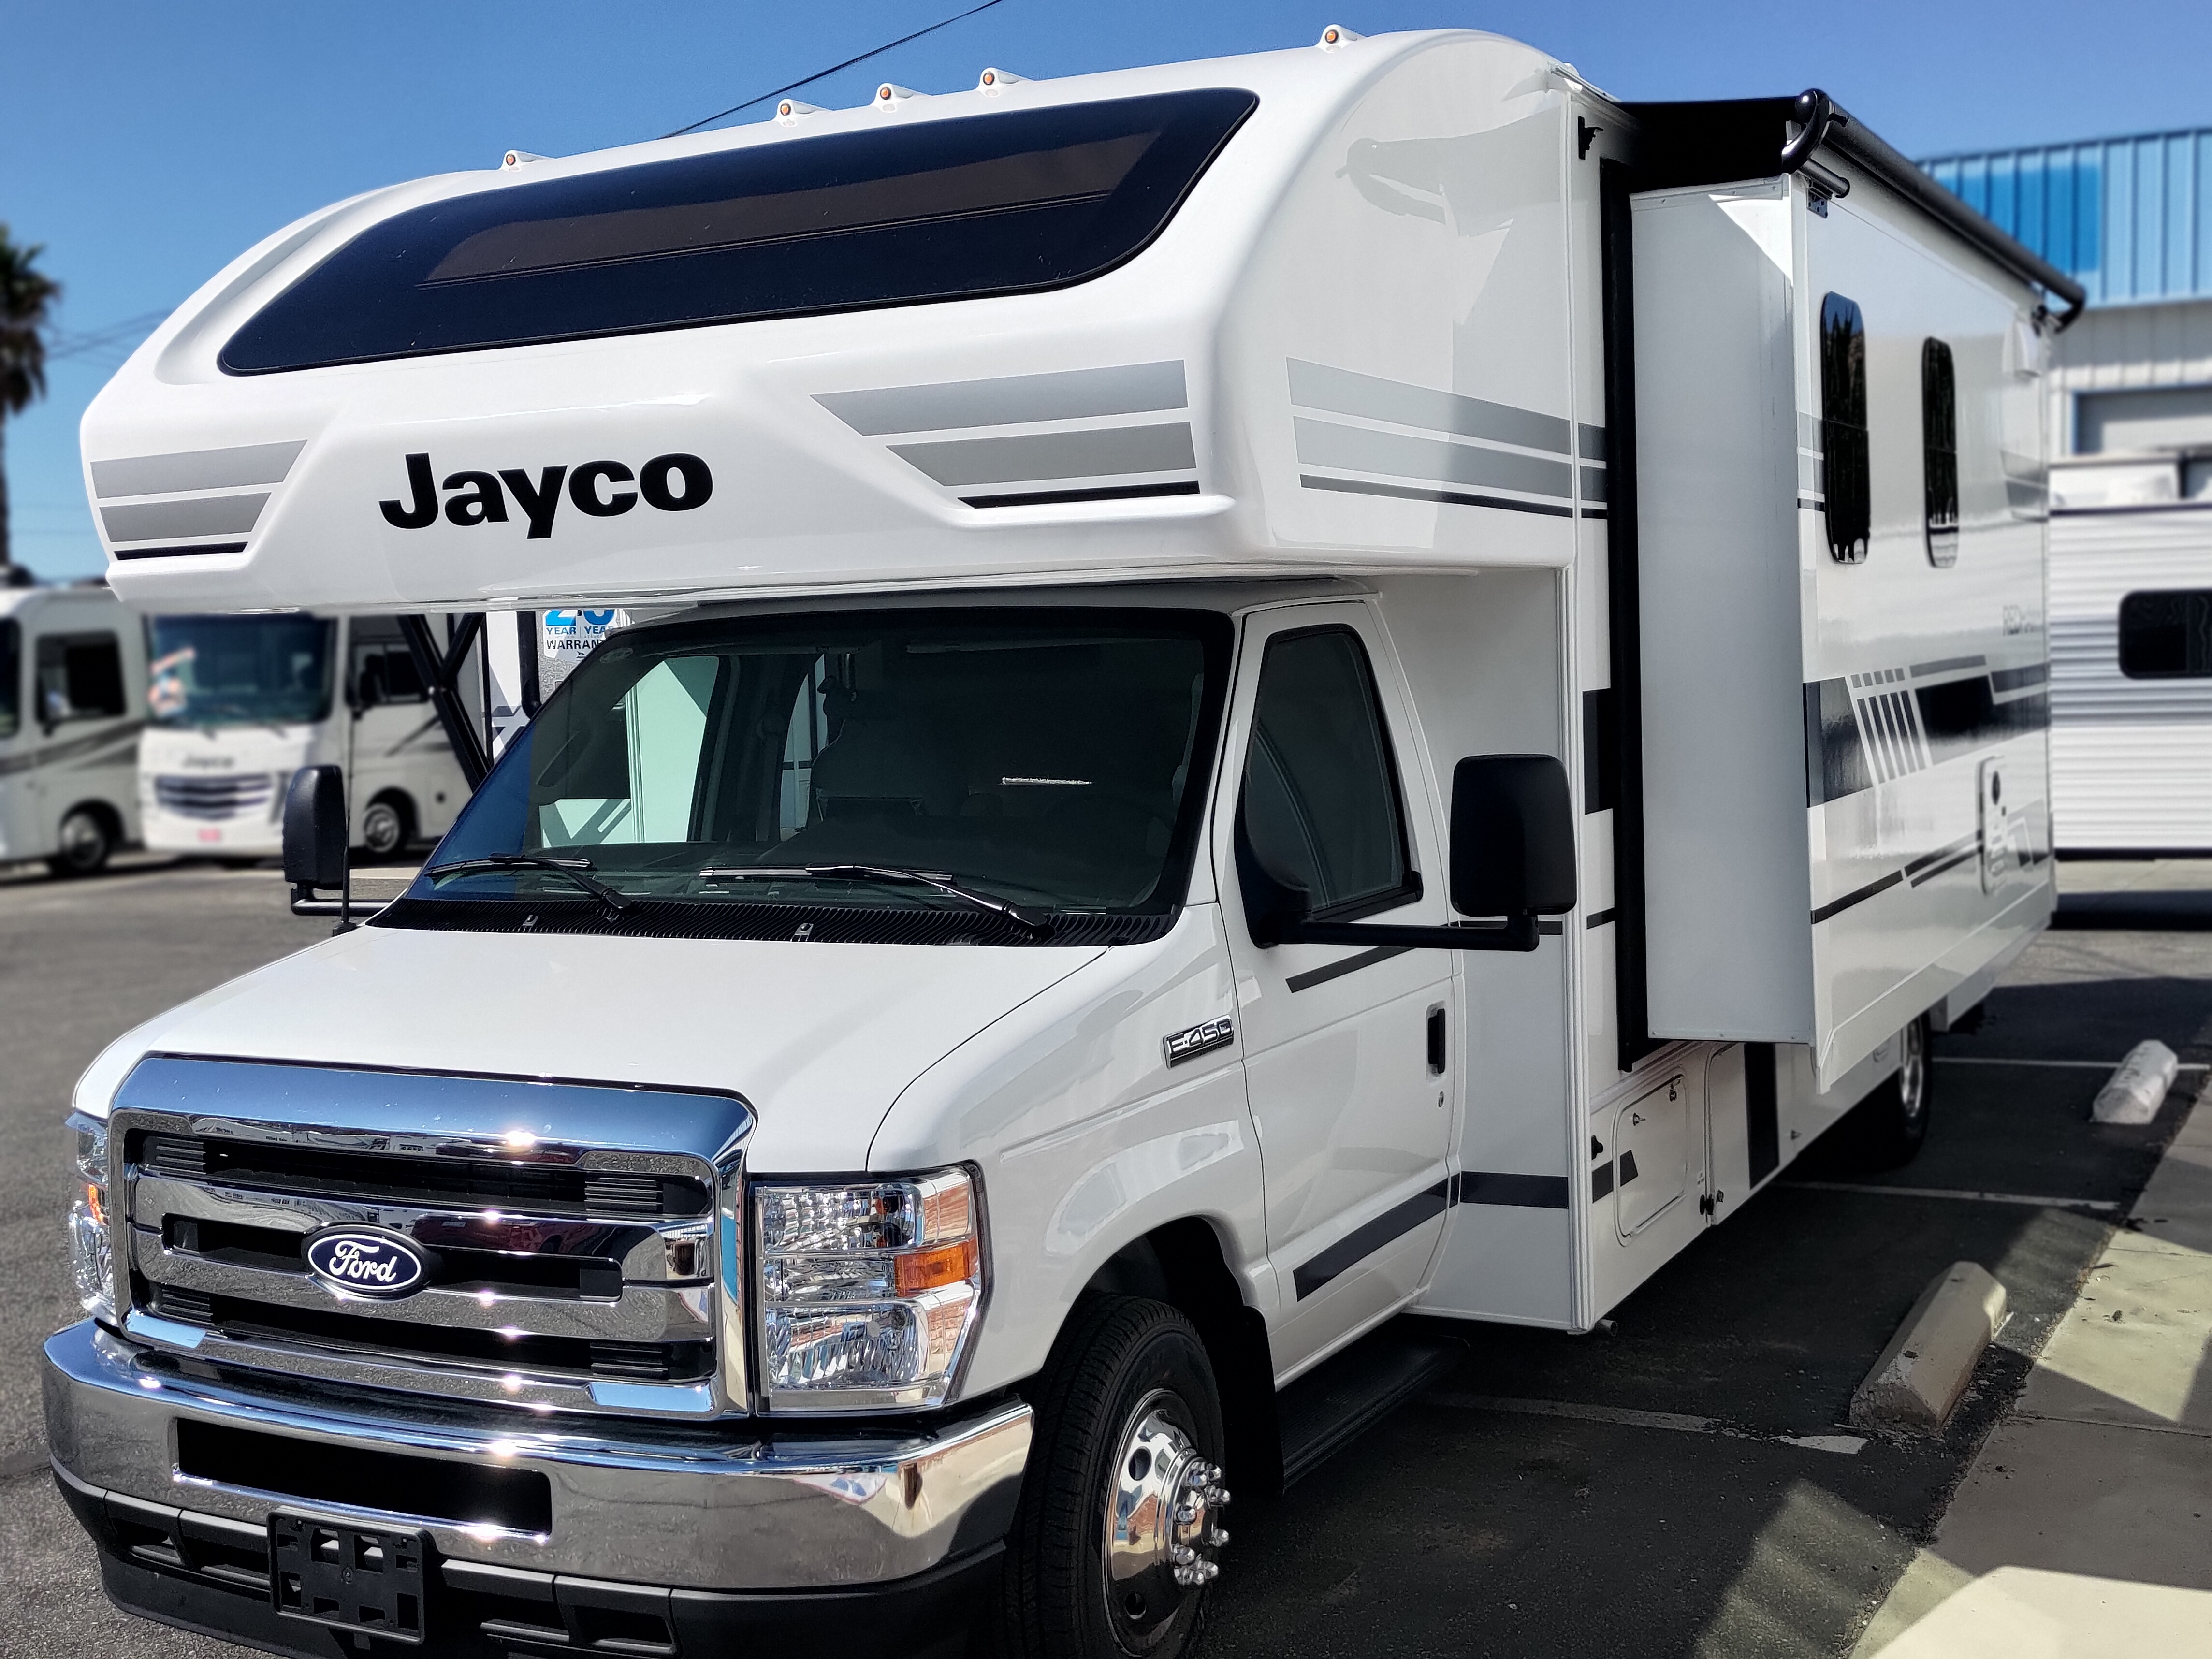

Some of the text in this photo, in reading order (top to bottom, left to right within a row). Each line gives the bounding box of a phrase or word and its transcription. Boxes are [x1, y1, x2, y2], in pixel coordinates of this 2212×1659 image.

[379, 453, 713, 539] Jayco
[584, 626, 609, 634] YEA
[547, 639, 601, 649] WARRAN
[329, 1240, 397, 1282] Ford
